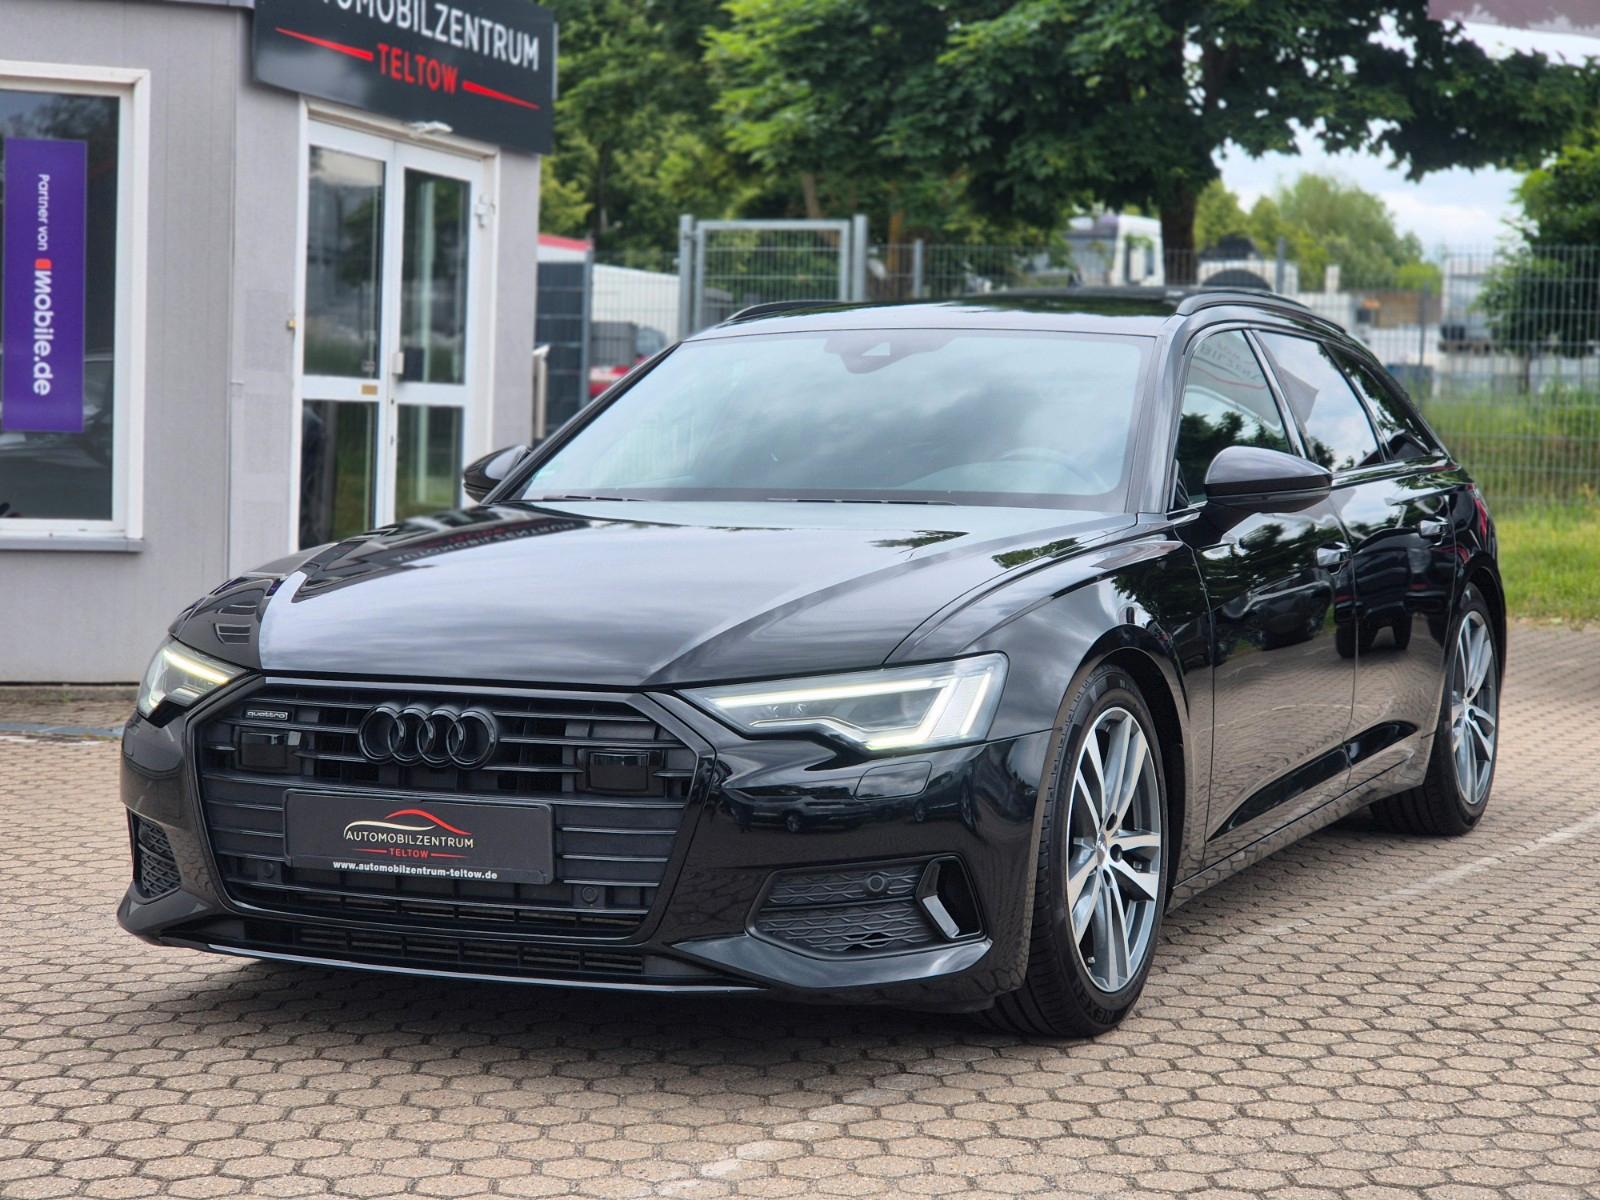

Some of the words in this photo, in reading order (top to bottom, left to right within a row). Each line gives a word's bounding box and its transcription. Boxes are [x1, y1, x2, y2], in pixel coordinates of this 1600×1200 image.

[377, 43, 458, 94] TELTOW
[37, 173, 50, 223] Partner
[37, 225, 49, 251] von
[247, 711, 286, 719] quattro
[345, 830, 474, 848] AUTOMOBILZENTRUM
[389, 848, 429, 859] TELTOW
[332, 861, 498, 879] www.automobilzentrum-teltow.de
